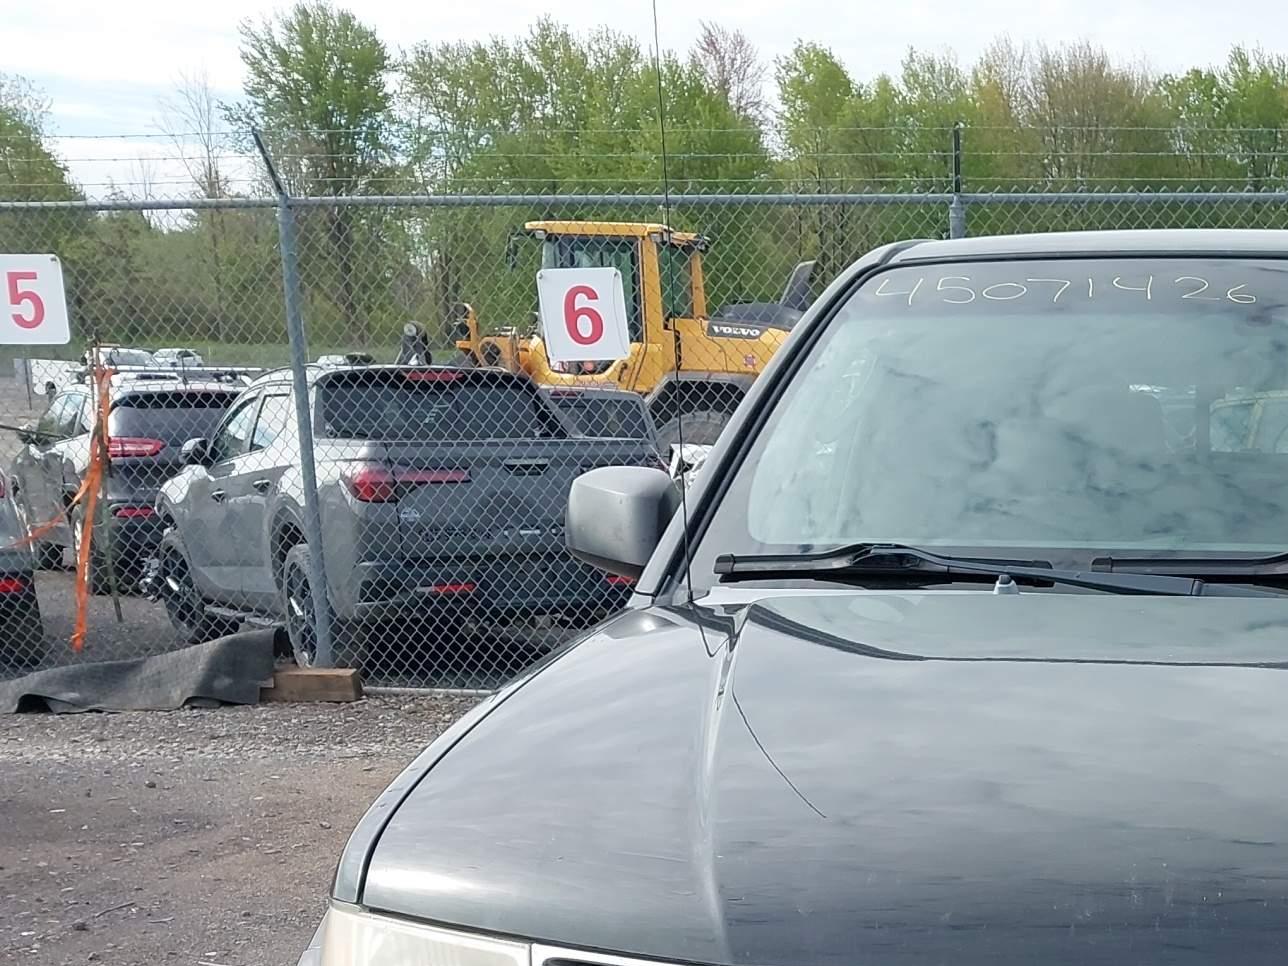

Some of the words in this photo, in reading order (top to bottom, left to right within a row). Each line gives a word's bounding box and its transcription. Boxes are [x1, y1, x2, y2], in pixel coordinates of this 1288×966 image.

[6, 271, 45, 329] 5
[876, 275, 1256, 305] 45071426
[564, 285, 604, 345] 6
[711, 325, 760, 336] VOLVO
